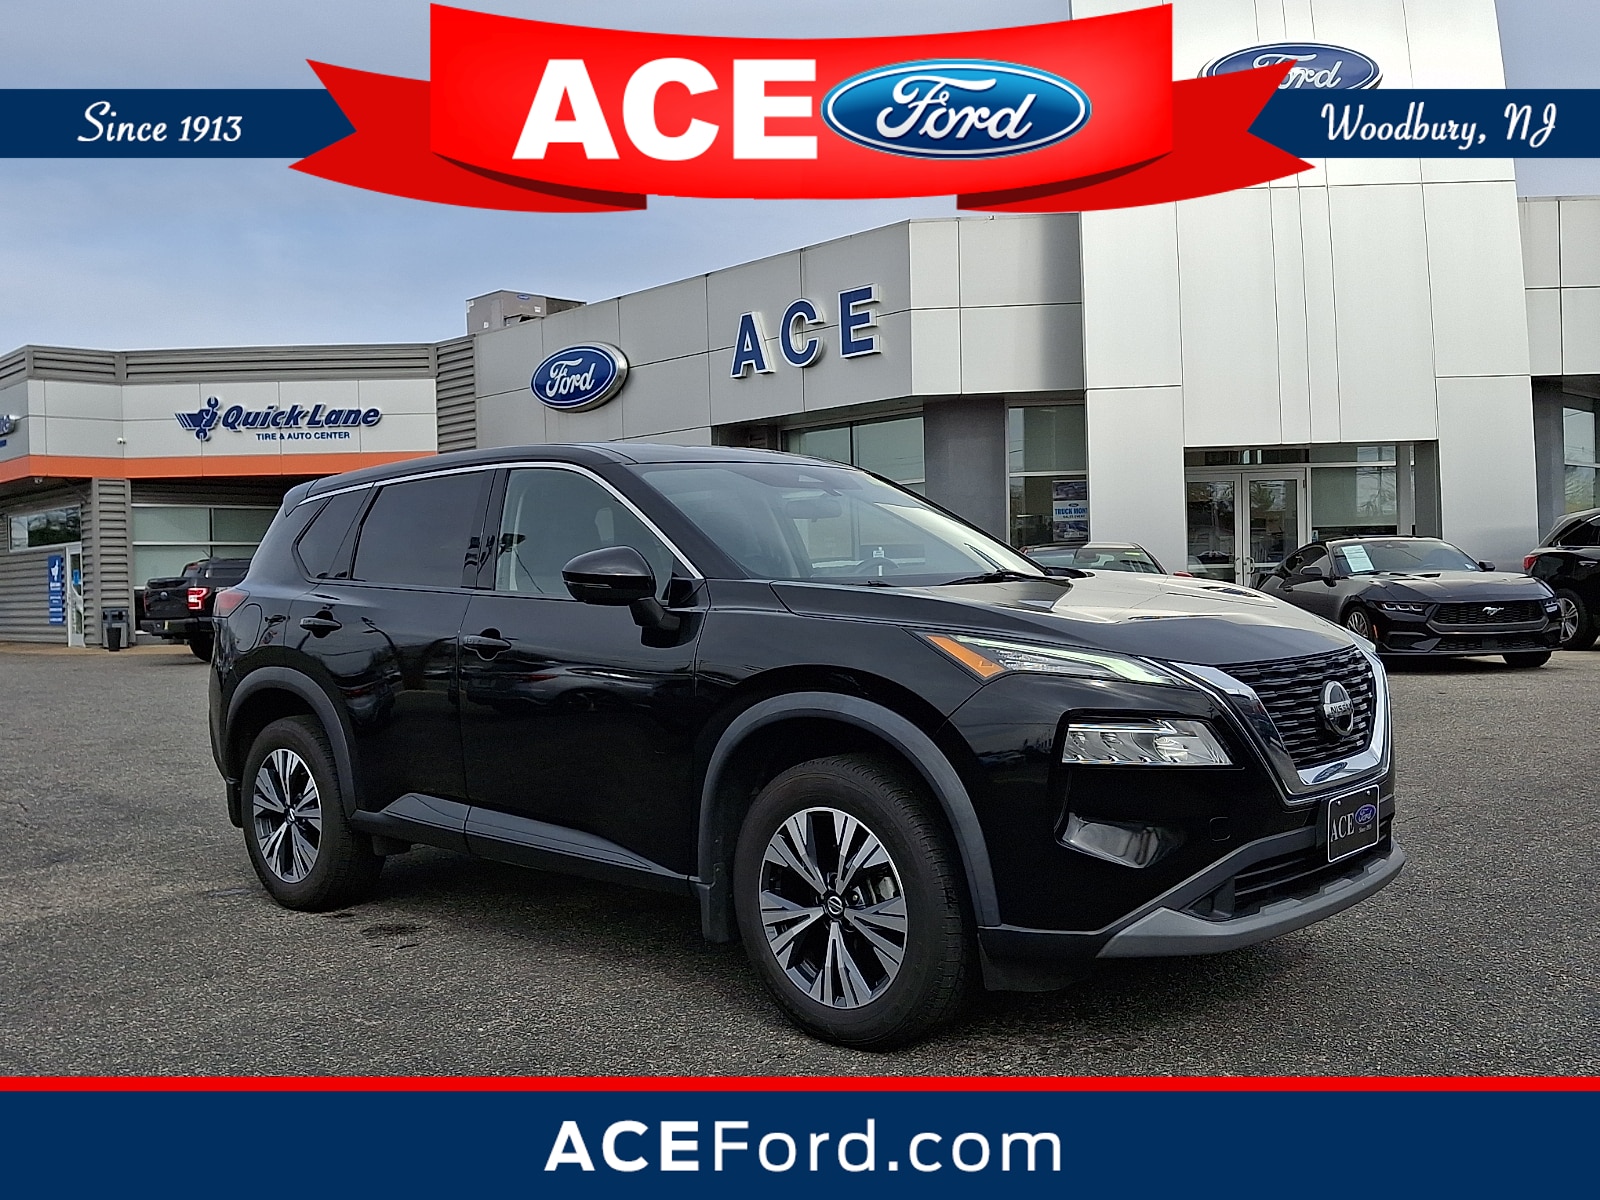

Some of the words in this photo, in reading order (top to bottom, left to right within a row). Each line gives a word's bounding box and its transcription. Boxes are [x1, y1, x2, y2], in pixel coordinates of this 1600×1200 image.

[730, 283, 881, 380] ACE
[545, 357, 597, 397] Ford
[221, 404, 307, 433] Quick
[306, 404, 381, 428] Lane
[256, 433, 277, 441] TIRE
[287, 432, 312, 440] AUTO
[314, 432, 350, 440] CENTER
[1330, 813, 1355, 843] ACE
[1358, 807, 1373, 823] Ford
